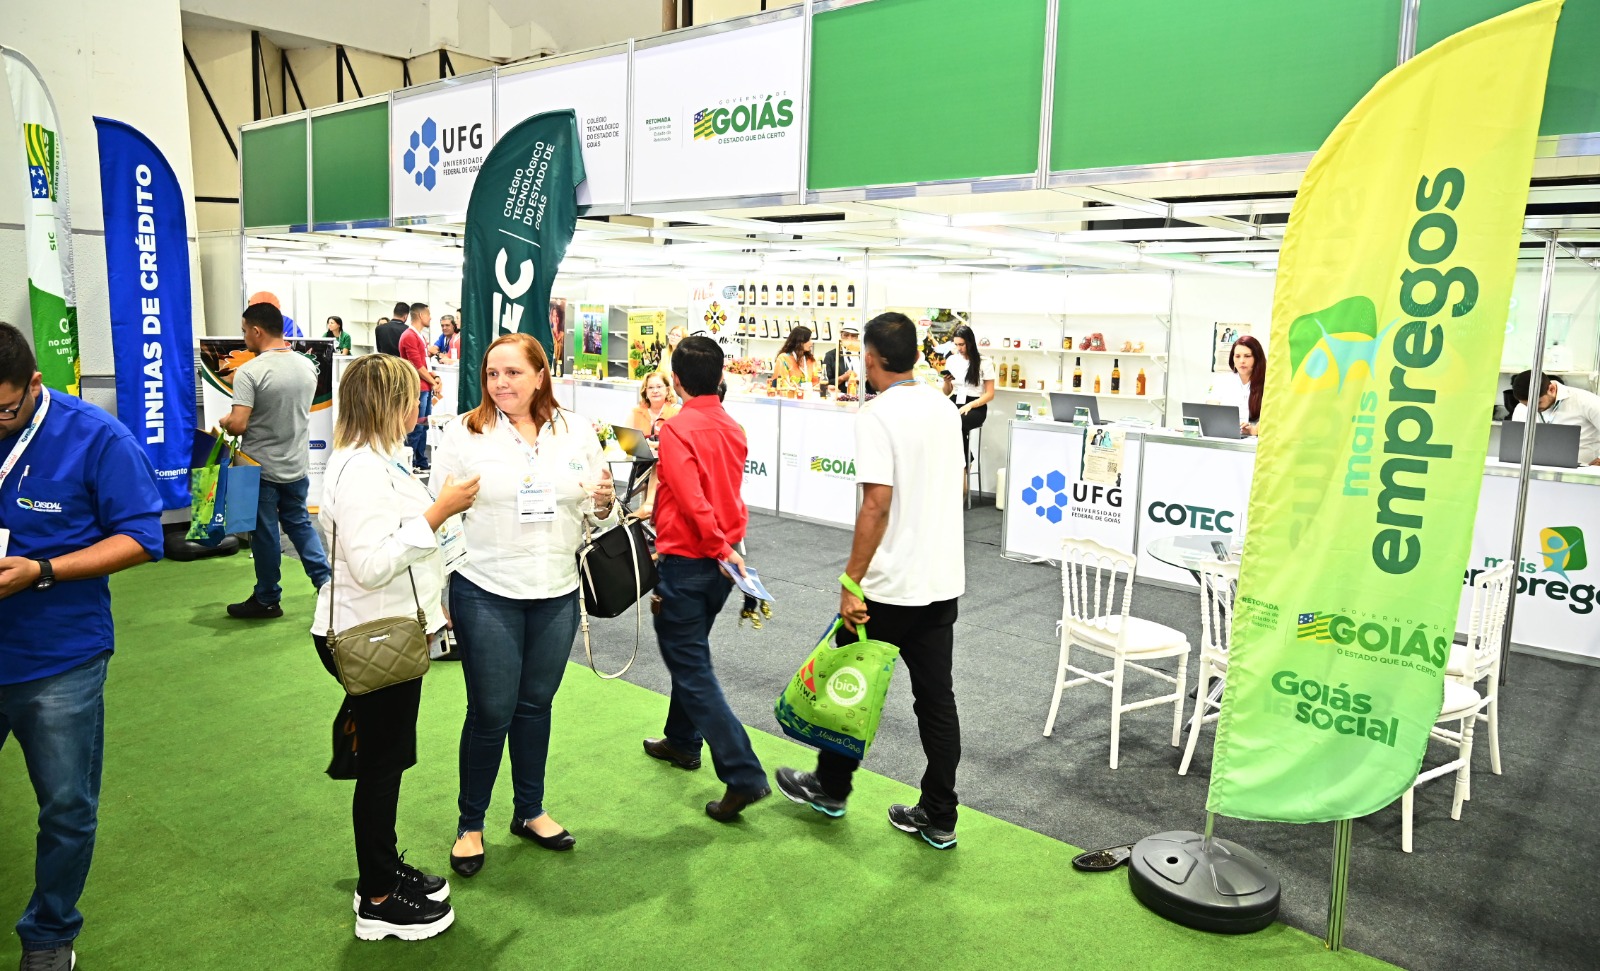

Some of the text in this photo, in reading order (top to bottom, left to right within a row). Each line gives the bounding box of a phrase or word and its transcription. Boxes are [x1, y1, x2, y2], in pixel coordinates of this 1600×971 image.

[719, 93, 764, 105] GOVERNO
[586, 116, 607, 124] COLÉGIO
[586, 122, 620, 132] TECNOLÓGICO
[712, 94, 793, 135] GOIÁS
[442, 123, 483, 153] UFG
[587, 140, 601, 148] GOIÁS
[723, 136, 744, 144] ESTADO
[745, 134, 757, 142] QUE
[758, 132, 766, 140] DÁ
[766, 131, 786, 139] CERTO
[443, 156, 483, 167] UNIVERSIDADE
[443, 167, 461, 175] FEDERAL
[469, 164, 481, 172] GOIÁ
[503, 168, 524, 218] COLÉGIO
[512, 141, 545, 220] TECNOLÓGICO
[523, 143, 556, 226] DO ESTADO DE
[48, 232, 57, 251] SIC
[135, 164, 165, 445] LINHAS DE CRÉDITO
[1372, 167, 1479, 575] empregos
[1342, 391, 1378, 497] mais
[821, 458, 856, 476] GOIÁ
[34, 501, 62, 510] DISDAL
[1073, 483, 1122, 507] UFG
[1072, 507, 1121, 518] UNIVERSIDADE
[1072, 512, 1094, 520] FEDERAL
[1148, 501, 1235, 533] COTEC
[1484, 557, 1537, 574] mis
[1341, 607, 1447, 633] GOVERNO DE
[1329, 615, 1447, 669] GOIÁS
[1345, 650, 1378, 662] ESTADO
[1380, 657, 1399, 665] QUE
[1401, 660, 1414, 669] DÁ
[1416, 664, 1437, 677] CERTO
[1271, 671, 1372, 715] Goiás
[1295, 701, 1399, 748] social
